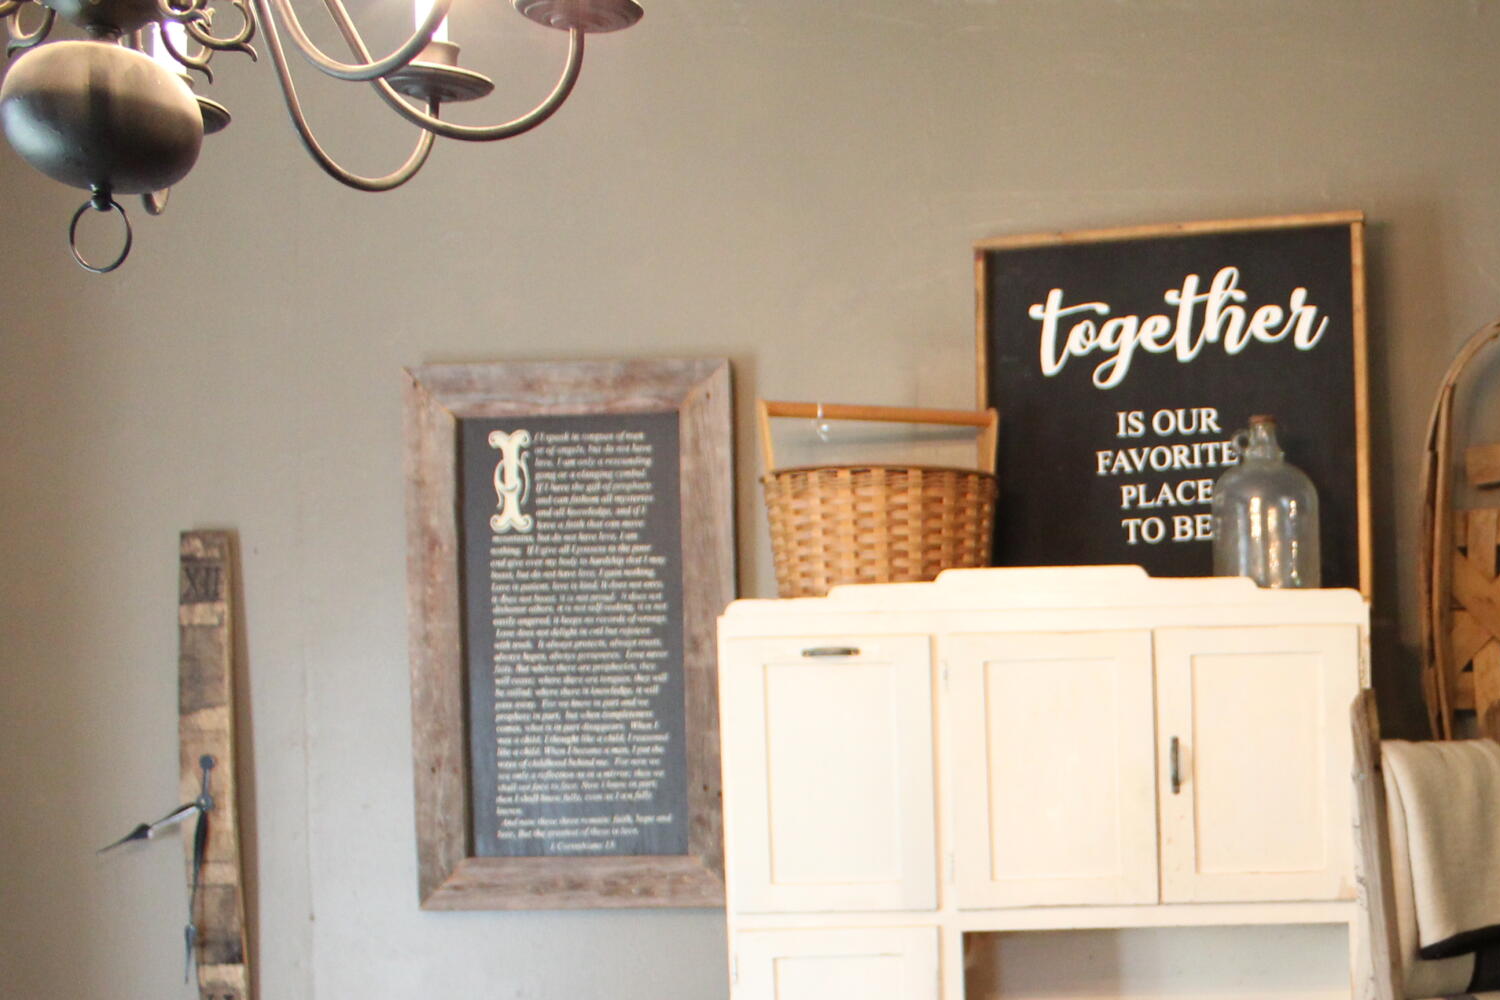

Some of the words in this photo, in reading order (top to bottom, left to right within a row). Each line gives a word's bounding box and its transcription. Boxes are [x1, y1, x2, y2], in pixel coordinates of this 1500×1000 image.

[1029, 266, 1329, 390] together
[1116, 411, 1145, 438] IS
[1152, 407, 1222, 436] OUR
[1095, 441, 1239, 476] FAVORITE
[1120, 479, 1215, 510] PLACE
[1122, 516, 1169, 545] TO
[1172, 514, 1215, 542] BE
